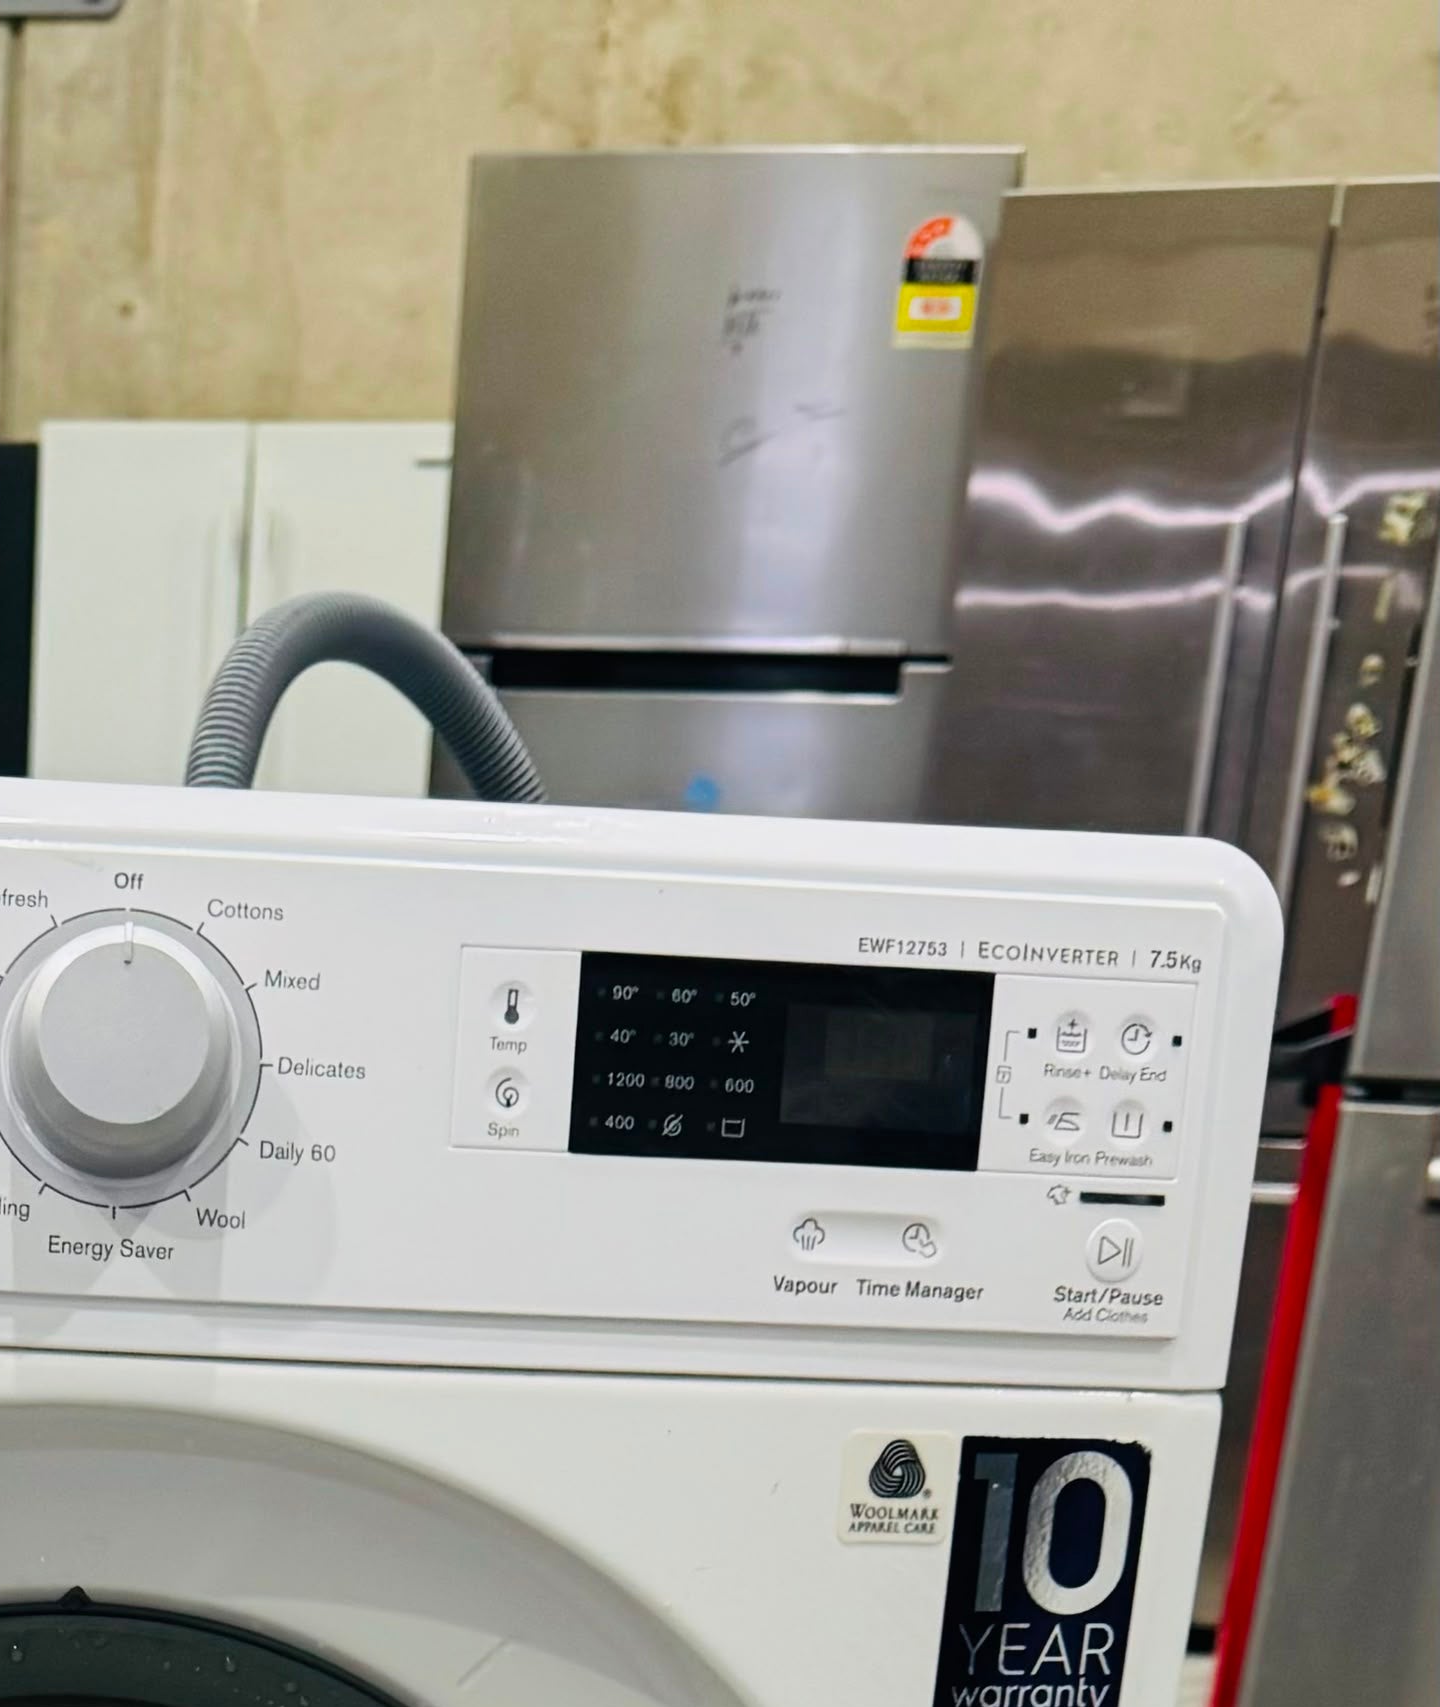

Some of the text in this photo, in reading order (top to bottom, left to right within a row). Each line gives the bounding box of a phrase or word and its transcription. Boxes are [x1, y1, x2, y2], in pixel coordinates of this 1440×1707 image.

[114, 872, 144, 891] Off
[207, 899, 284, 922] Cottons
[858, 937, 948, 958] EWF12753
[264, 971, 321, 992] Mixed
[489, 1036, 527, 1054] Temp
[277, 1057, 366, 1080] Delicates
[1099, 1065, 1167, 1084] Delay End
[607, 1071, 645, 1089] 1200
[664, 1074, 695, 1091] 800
[724, 1077, 754, 1094] 600
[487, 1122, 520, 1139] Spin
[604, 1114, 635, 1131] 400
[259, 1140, 336, 1166] Daily 60
[1029, 1148, 1092, 1167] Easy Iron
[1095, 1150, 1153, 1167] Prewash
[196, 1208, 246, 1230] Wool
[48, 1235, 175, 1262] Energy Saver
[773, 1275, 838, 1296] Vapour
[856, 1278, 984, 1302] Time Manager
[1054, 1286, 1164, 1307] Start/Pause
[1063, 1307, 1148, 1324] Add Clothes
[850, 1503, 940, 1522] WOOLMARK
[848, 1519, 936, 1535] APPAREL CARE
[973, 1450, 1134, 1616] 10
[959, 1622, 1116, 1677] YEAR
